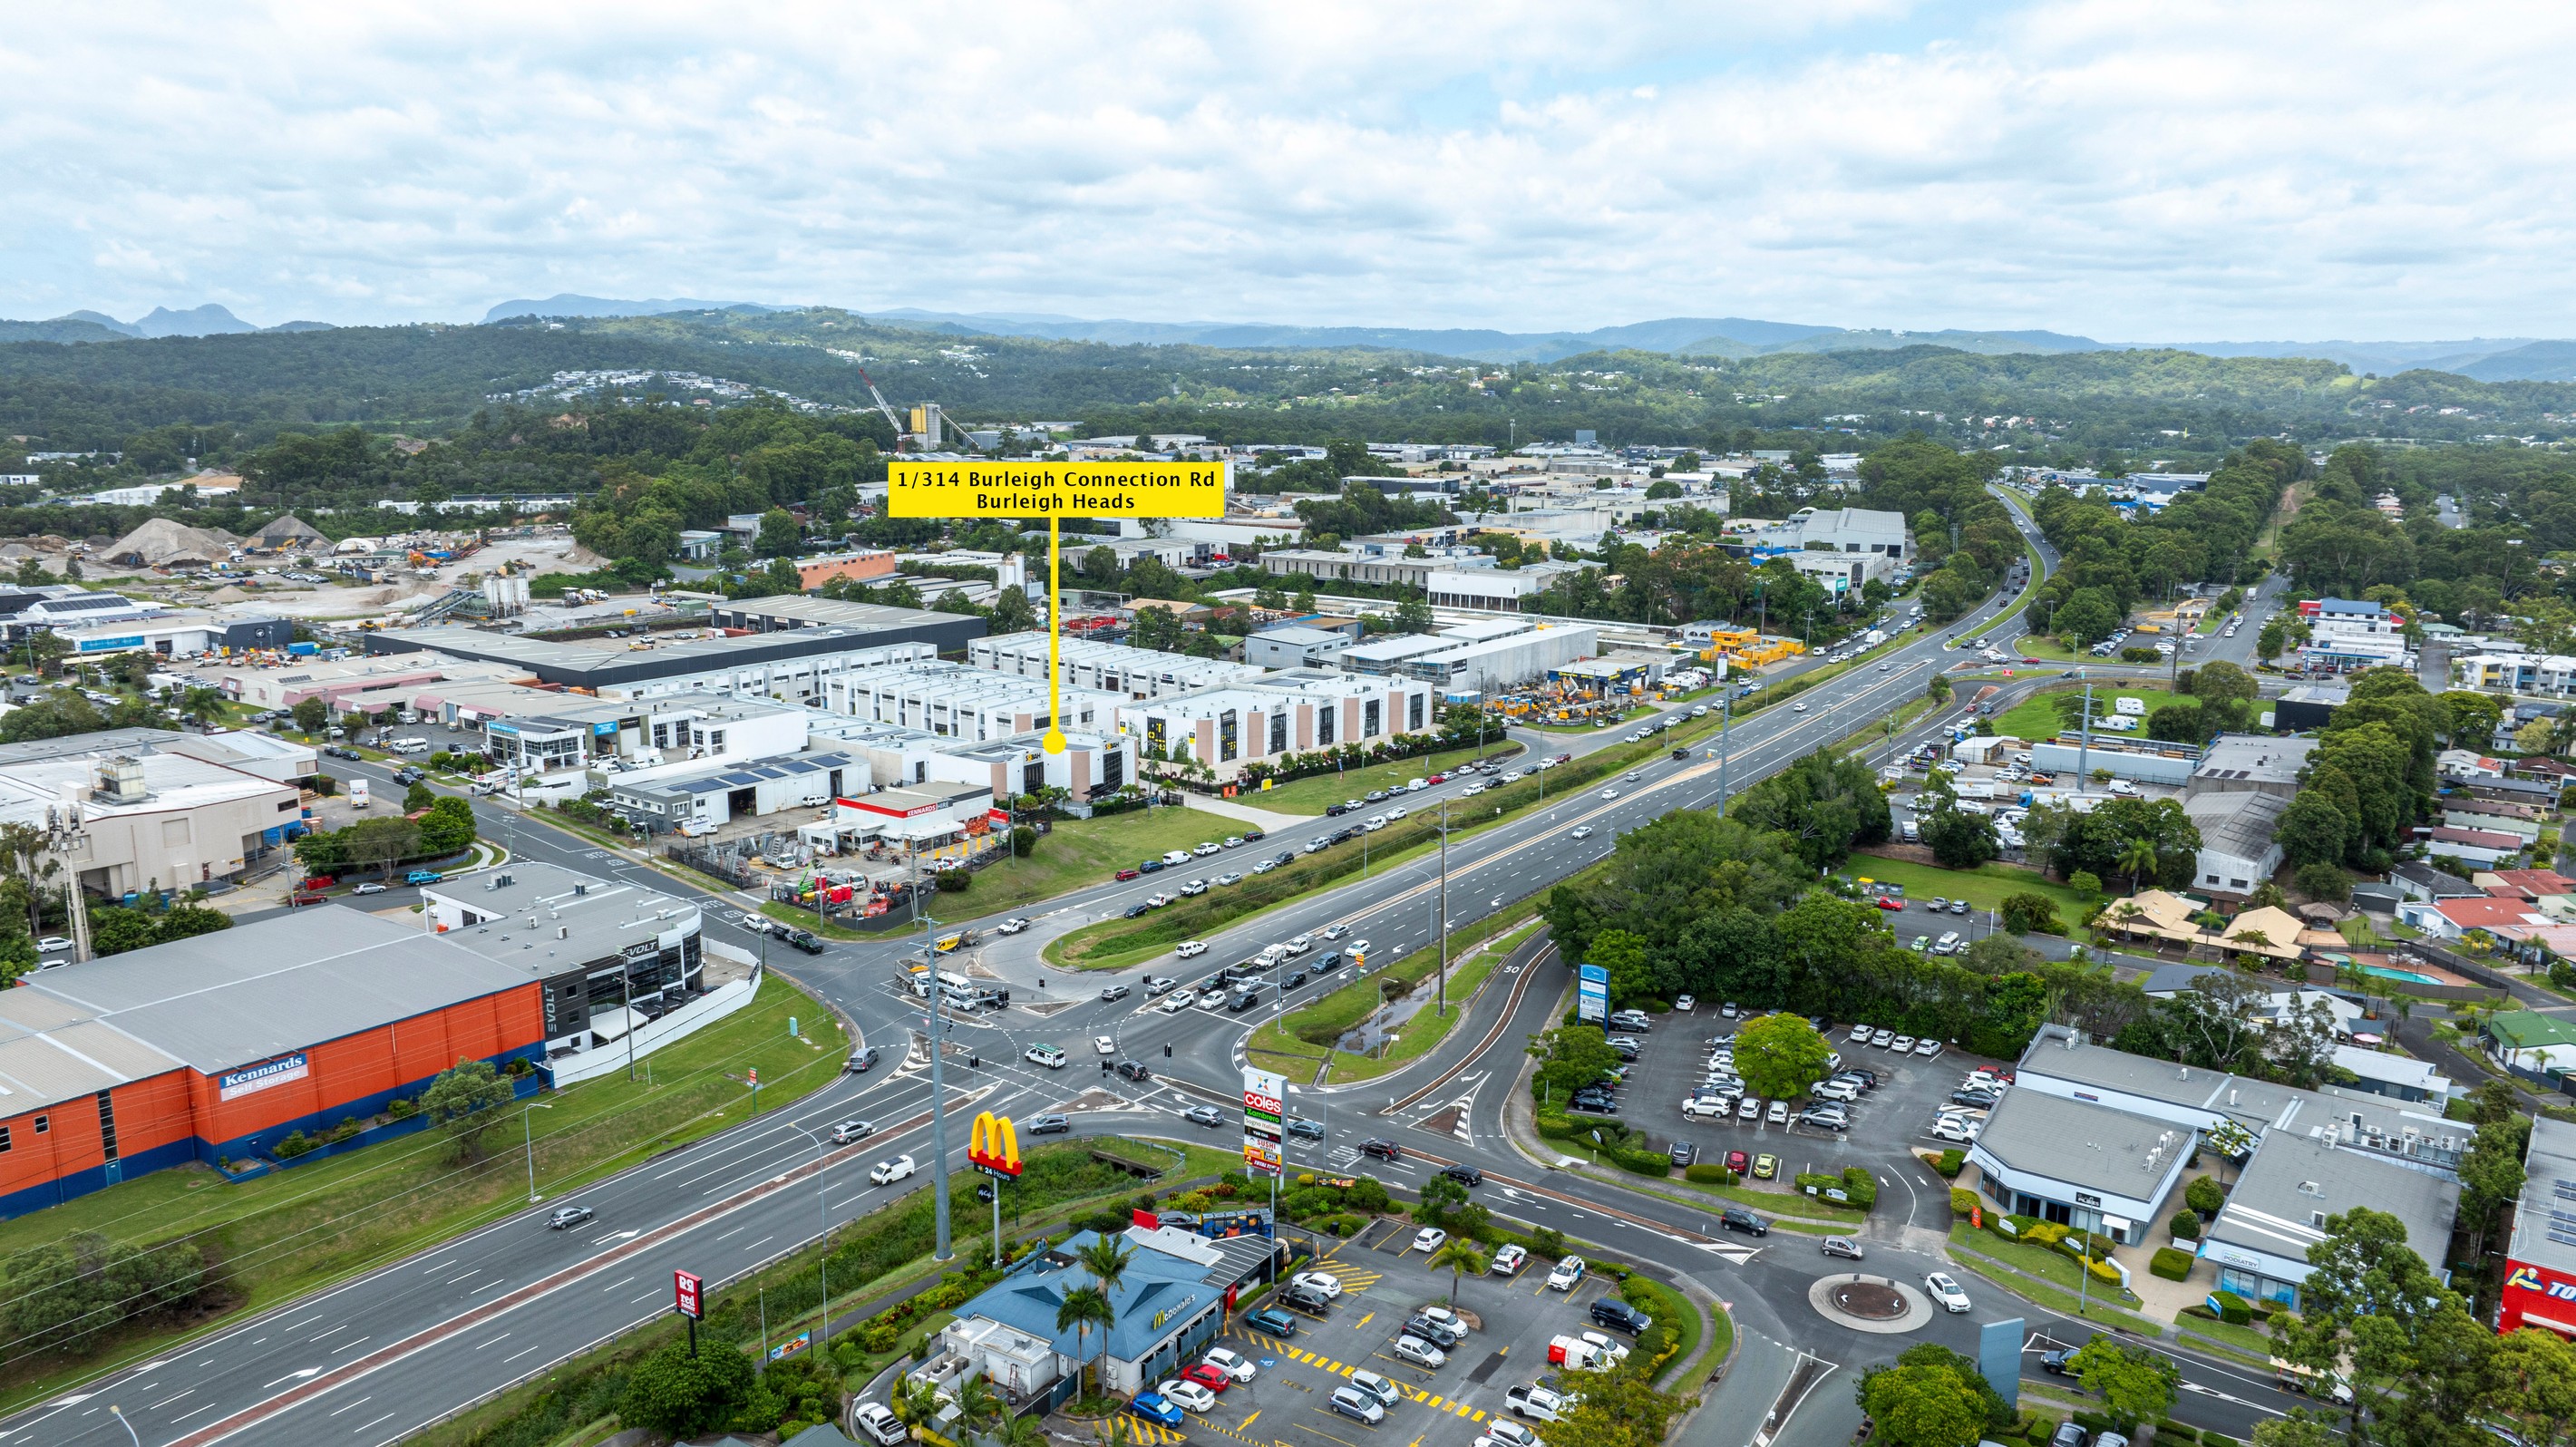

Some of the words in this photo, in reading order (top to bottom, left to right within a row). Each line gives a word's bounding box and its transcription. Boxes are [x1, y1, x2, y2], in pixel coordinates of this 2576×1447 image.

[907, 805, 936, 816] KENNARDS
[938, 801, 948, 810] HIRE
[1503, 966, 1520, 974] 50
[225, 1056, 303, 1087] Kennards
[228, 1083, 252, 1096] Self
[257, 1070, 300, 1088] Storage
[1245, 1093, 1281, 1113] coles
[1247, 1107, 1280, 1122] Zambrero
[1245, 1118, 1261, 1127] Sogno
[1261, 1121, 1281, 1132] Italiano
[1257, 1139, 1276, 1150] SUSHI
[985, 1167, 993, 1175] 24
[993, 1170, 1011, 1181] Hours
[2224, 1256, 2258, 1267] PODIATRY
[2547, 1281, 2576, 1300] TO
[680, 1294, 695, 1306] red
[1153, 1294, 1196, 1330] McDonald's
